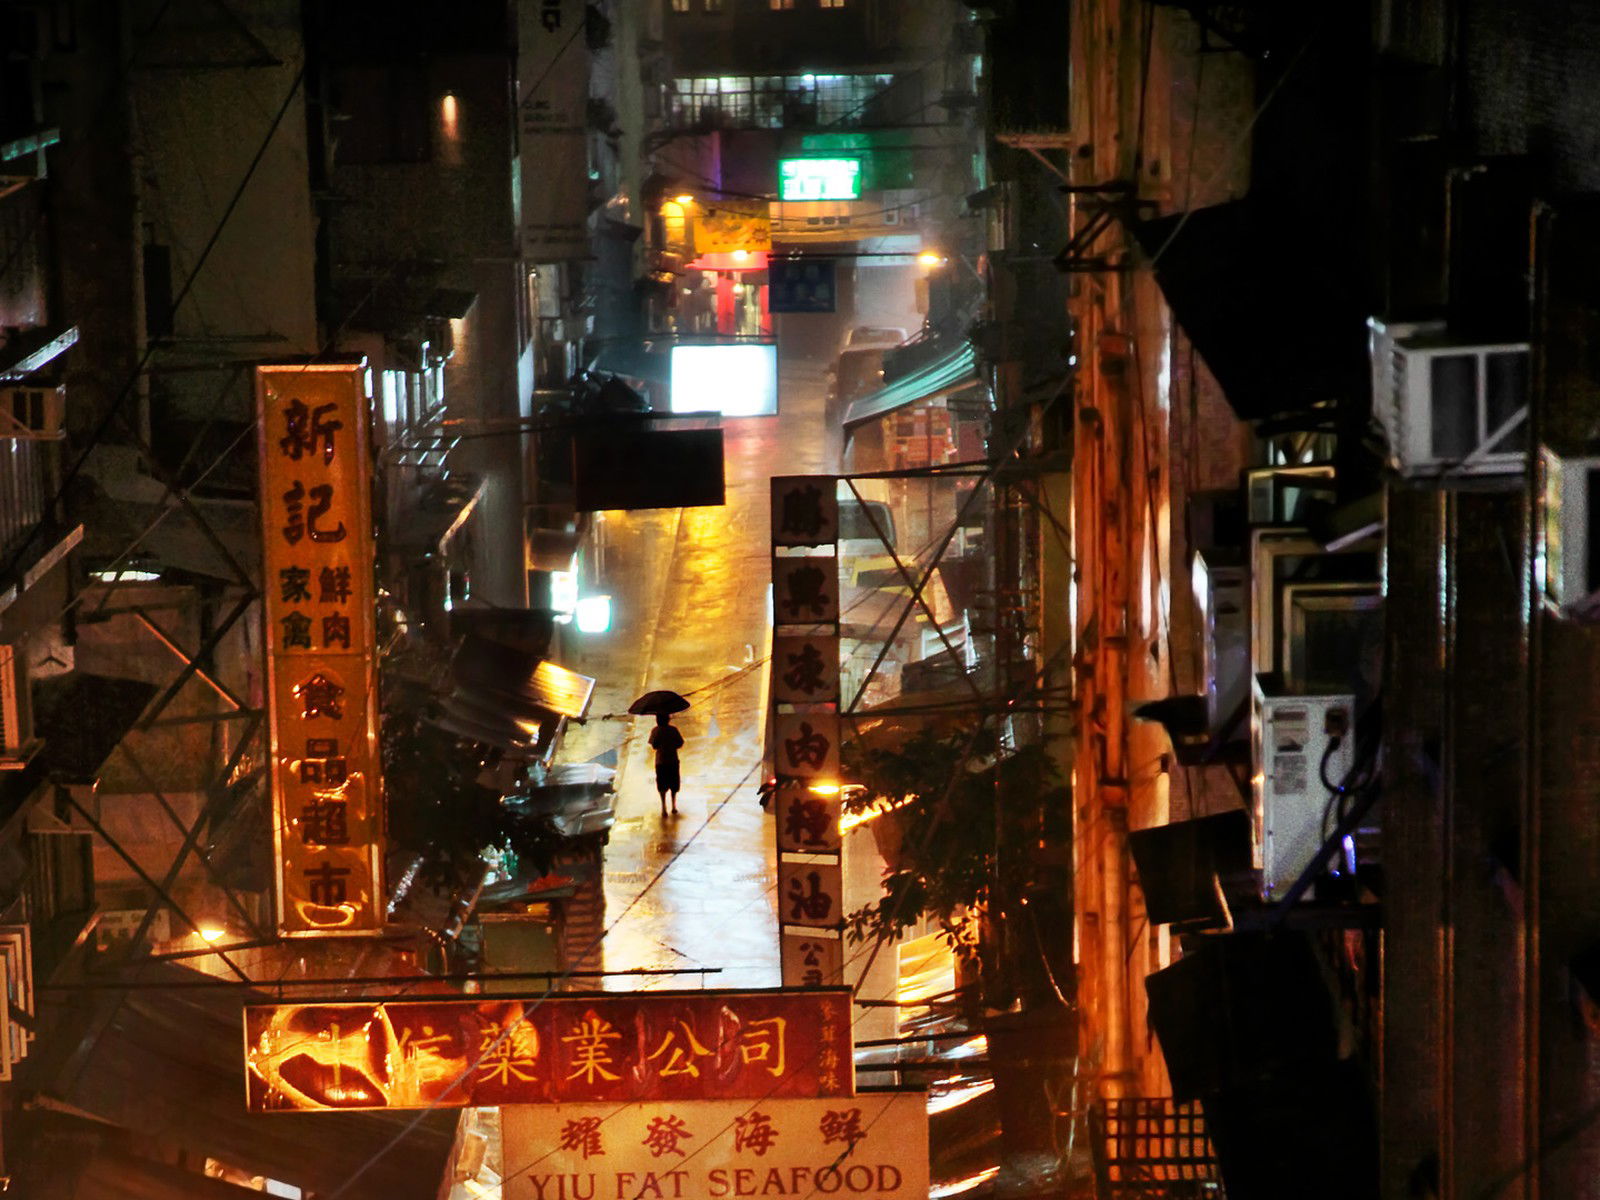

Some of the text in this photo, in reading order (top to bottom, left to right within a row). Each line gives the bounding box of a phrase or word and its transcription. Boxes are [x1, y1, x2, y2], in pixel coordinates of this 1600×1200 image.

[279, 398, 348, 546] 新記
[278, 565, 312, 651] 家禽
[318, 565, 352, 650] 鮮肉
[293, 673, 351, 906] 食品超市
[560, 1108, 868, 1160] 耀發海鮮
[616, 1171, 689, 1200] FAT
[708, 1164, 903, 1196] SEAFOOD
